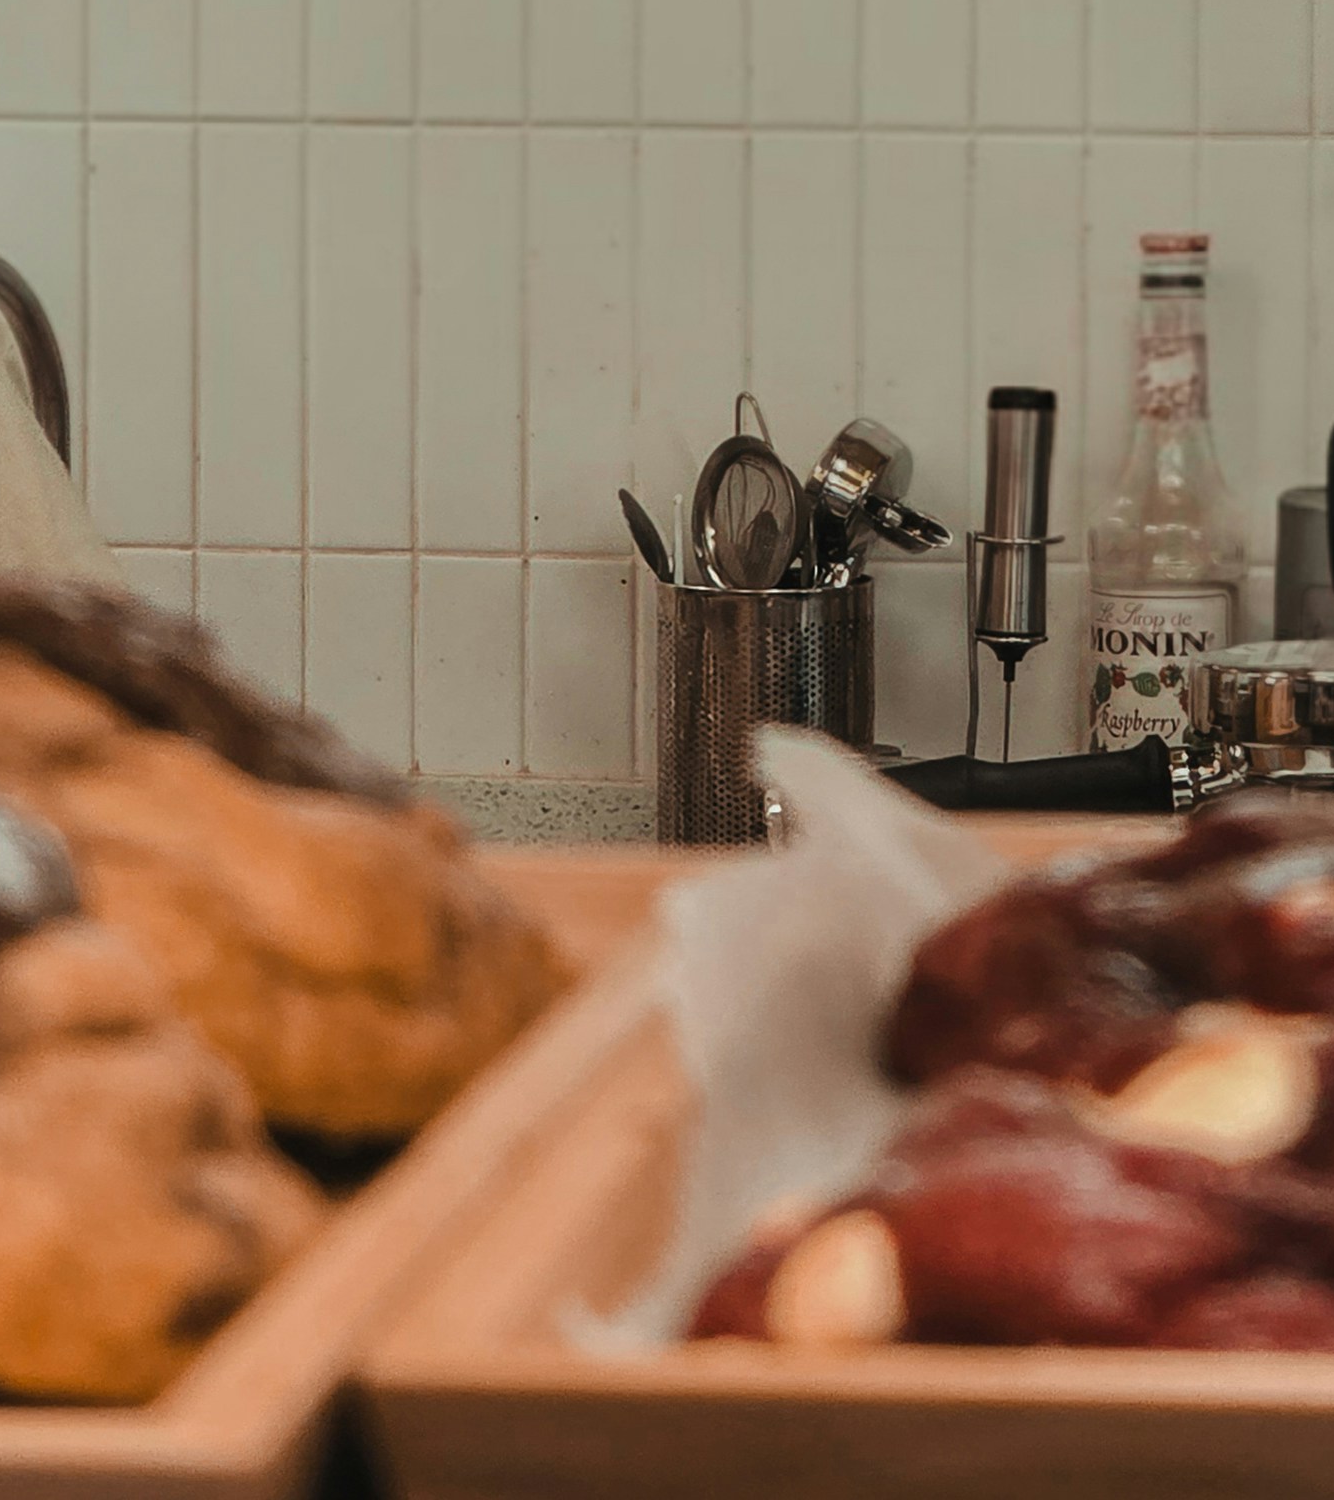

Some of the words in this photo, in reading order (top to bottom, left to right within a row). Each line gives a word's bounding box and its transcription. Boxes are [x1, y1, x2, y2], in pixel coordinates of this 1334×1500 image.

[1096, 602, 1116, 624] Le
[1117, 602, 1166, 630] Sirop
[1170, 612, 1193, 627] de
[1099, 703, 1181, 739] Raspberry
